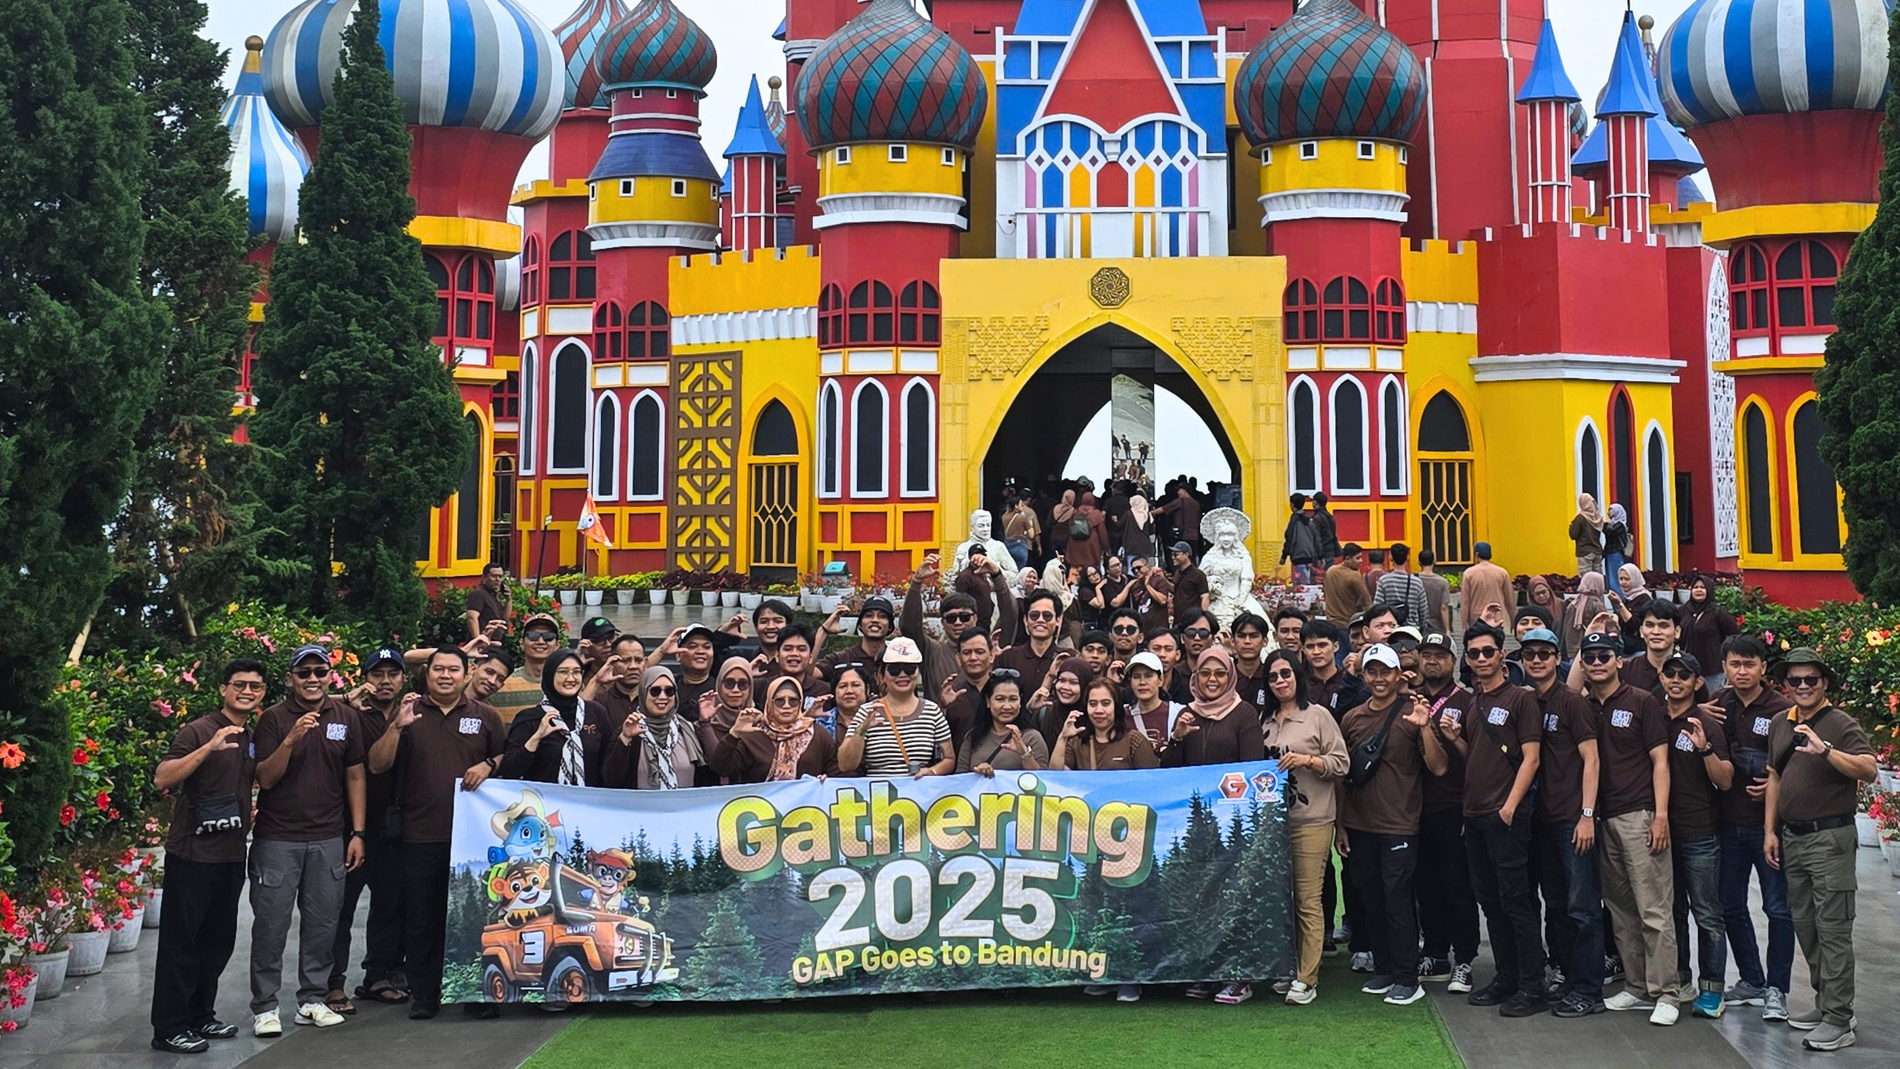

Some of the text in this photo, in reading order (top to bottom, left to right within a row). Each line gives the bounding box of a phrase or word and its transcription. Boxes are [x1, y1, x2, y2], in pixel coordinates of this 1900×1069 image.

[717, 772, 1152, 879] Gathering
[808, 855, 1057, 952] 2025
[521, 930, 545, 965] 3
[566, 924, 596, 934] SUMA
[792, 938, 1107, 984] GAP Goes to Bandung
